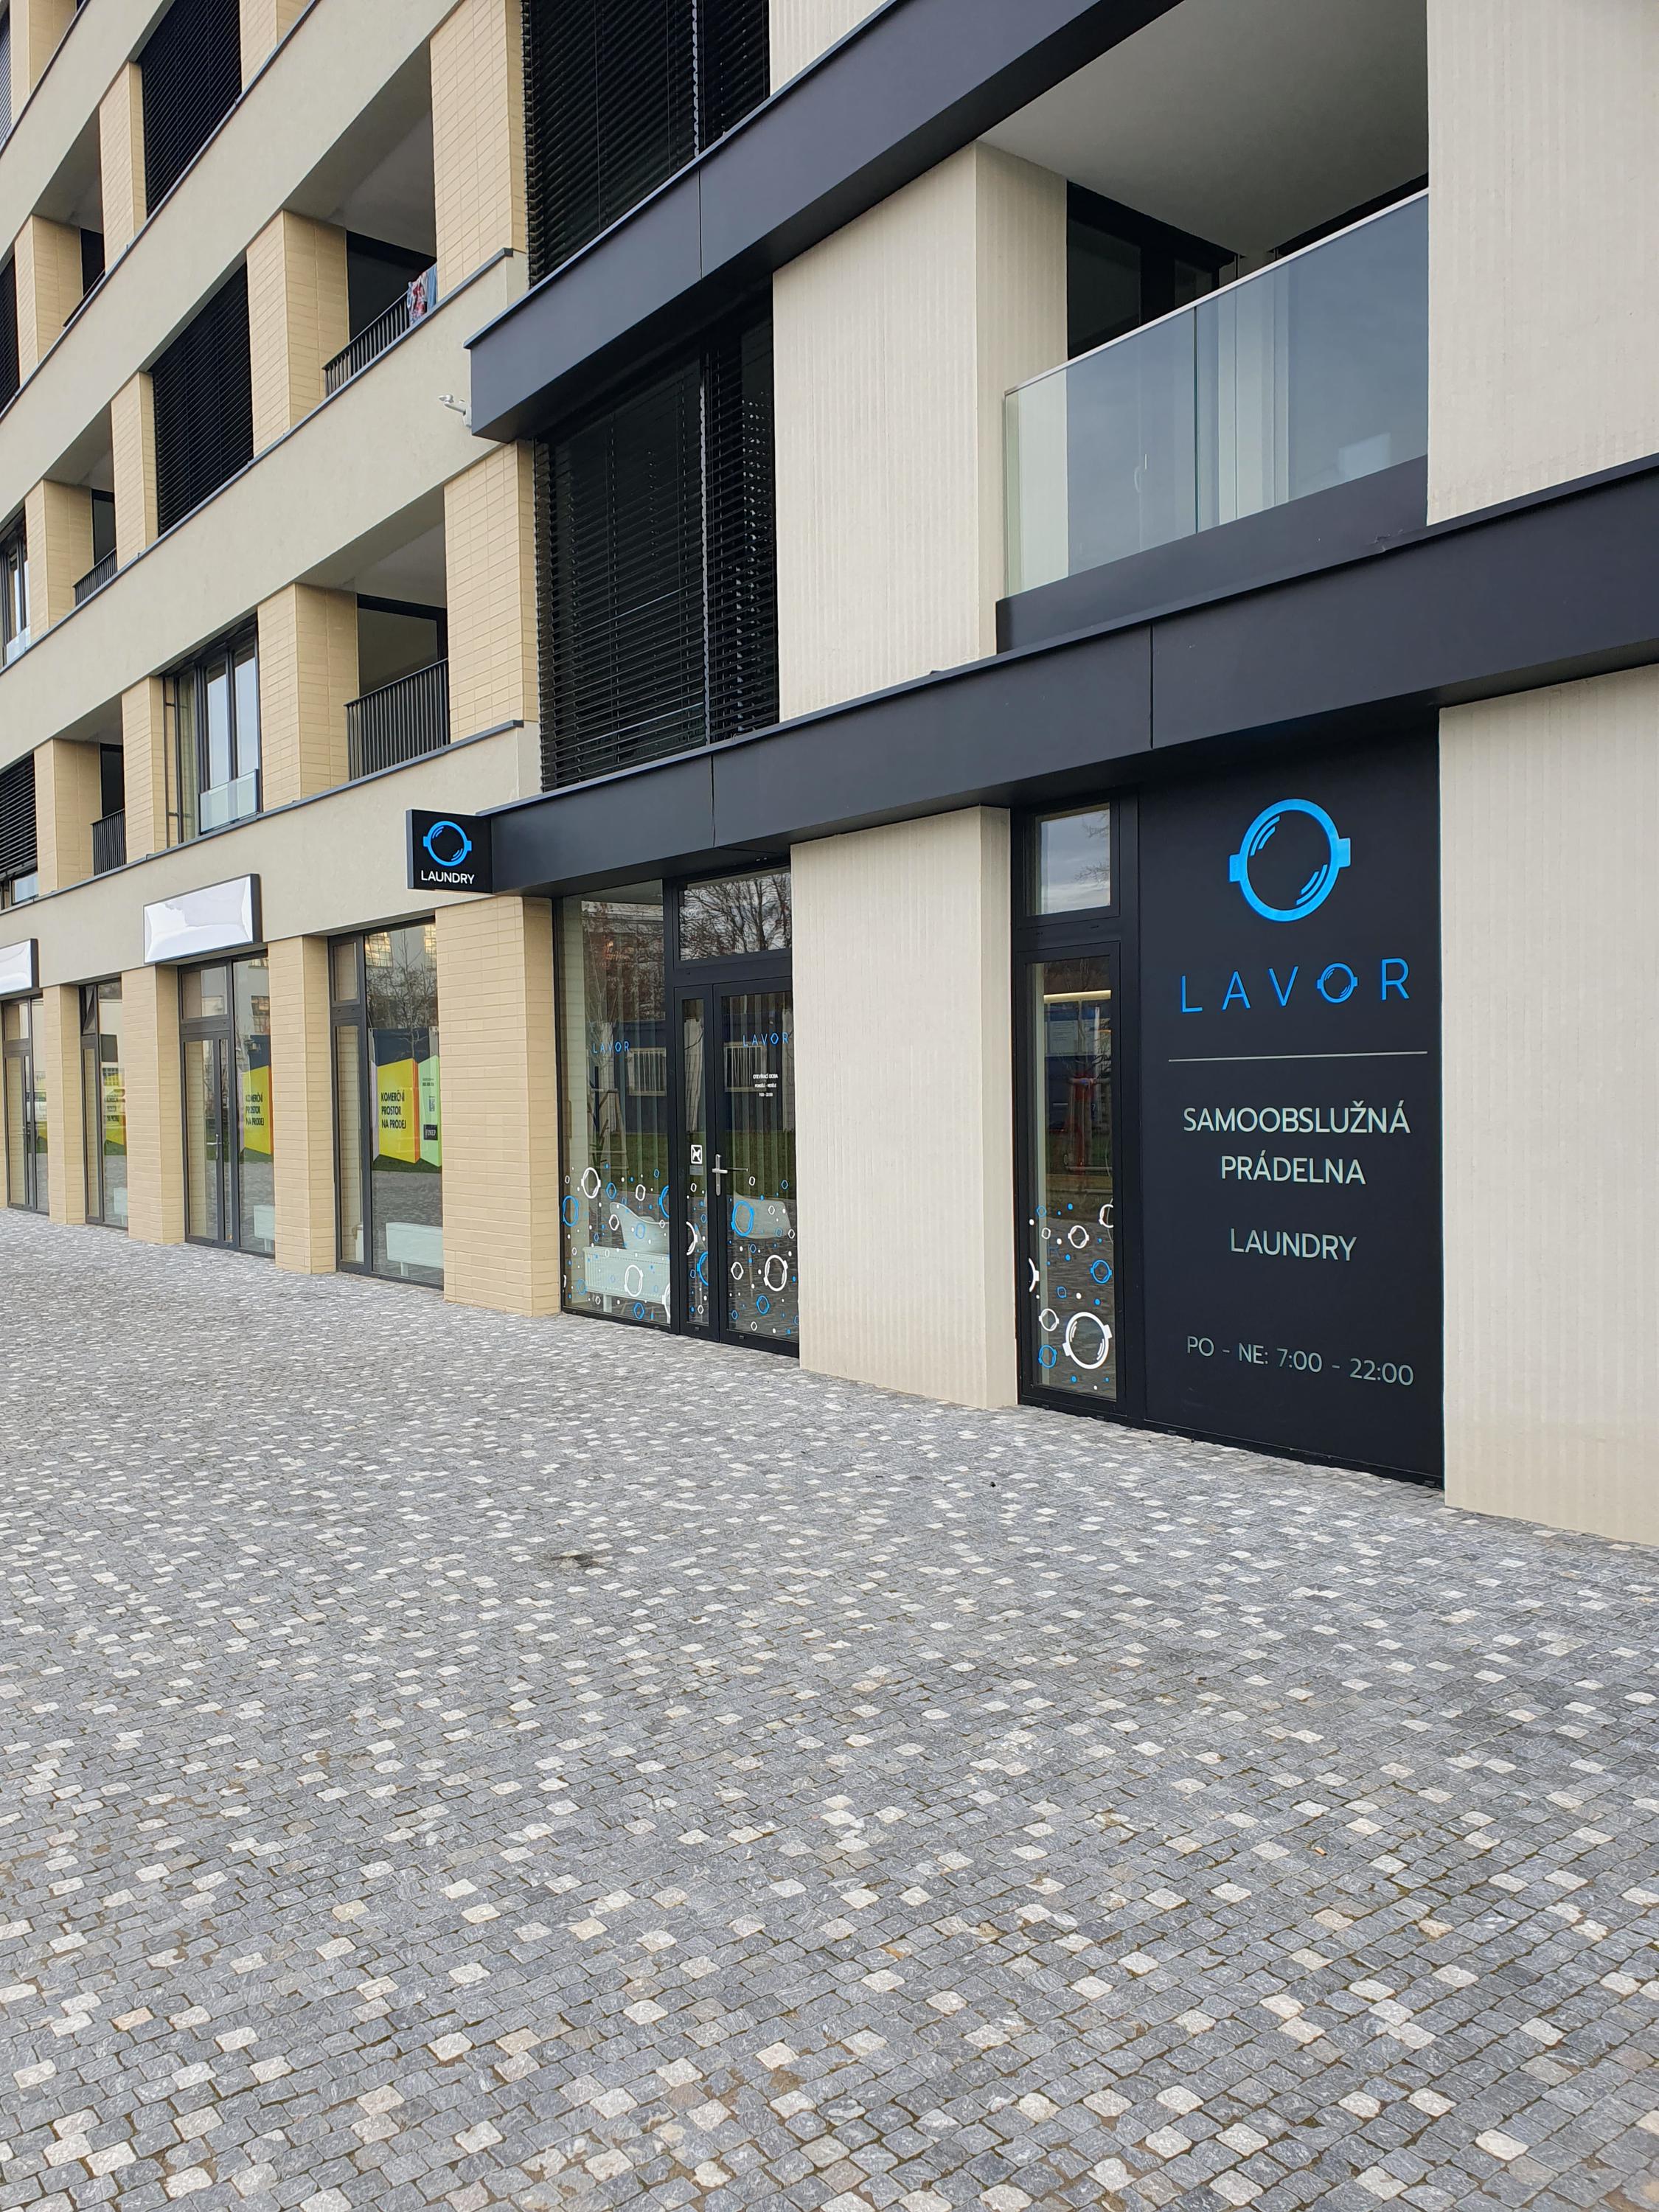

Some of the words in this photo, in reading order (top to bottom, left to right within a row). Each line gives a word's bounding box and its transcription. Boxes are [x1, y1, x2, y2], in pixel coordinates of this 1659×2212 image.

[420, 870, 475, 884] LAUNDRY
[1180, 957, 1410, 1013] LAVOR
[593, 1040, 630, 1054] LAVOR
[742, 1032, 789, 1048] LAVOR
[380, 1090, 405, 1102] KOMERČNÍ
[381, 1106, 401, 1116] PROSTOR
[1183, 1100, 1411, 1133] SAMOOBSLUŽNÁ
[381, 1119, 389, 1128] NA
[389, 1119, 406, 1129] PRODEJ
[1221, 1150, 1366, 1186] PRÁDELNA
[1231, 1228, 1357, 1262] LAUNDRY
[1186, 1335, 1215, 1357] PO
[1238, 1342, 1268, 1365] NE:
[1276, 1348, 1323, 1373] 7:00
[1349, 1357, 1414, 1386] 22:00
